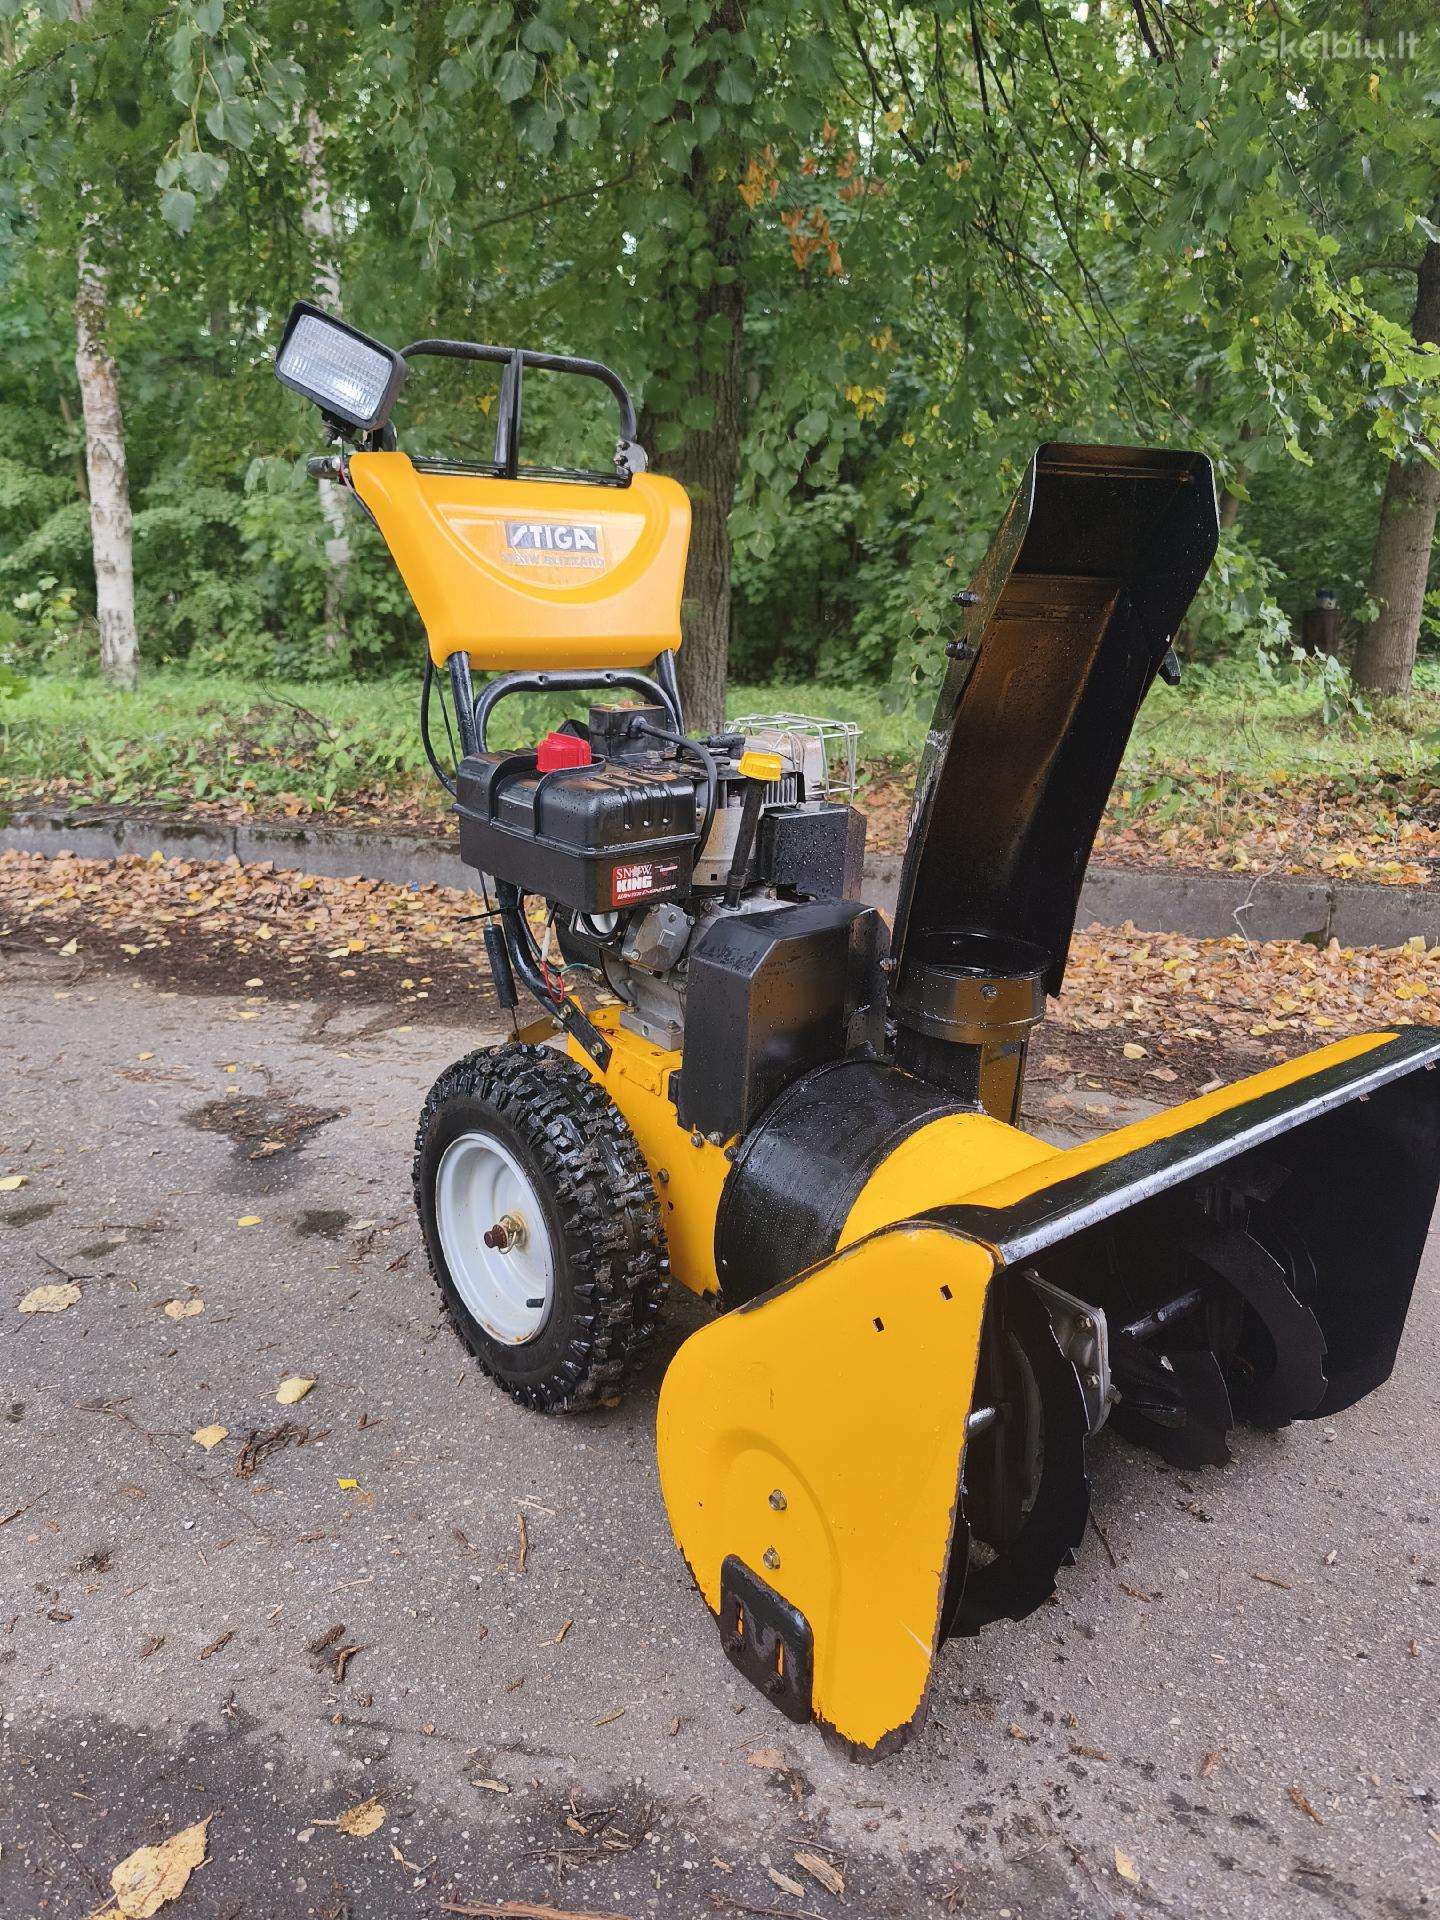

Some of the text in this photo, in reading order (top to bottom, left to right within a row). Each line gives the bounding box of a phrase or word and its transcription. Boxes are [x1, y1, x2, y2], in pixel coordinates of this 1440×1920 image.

[510, 524, 596, 550] STIGA
[616, 864, 652, 880] SNOW
[616, 875, 652, 893] KING
